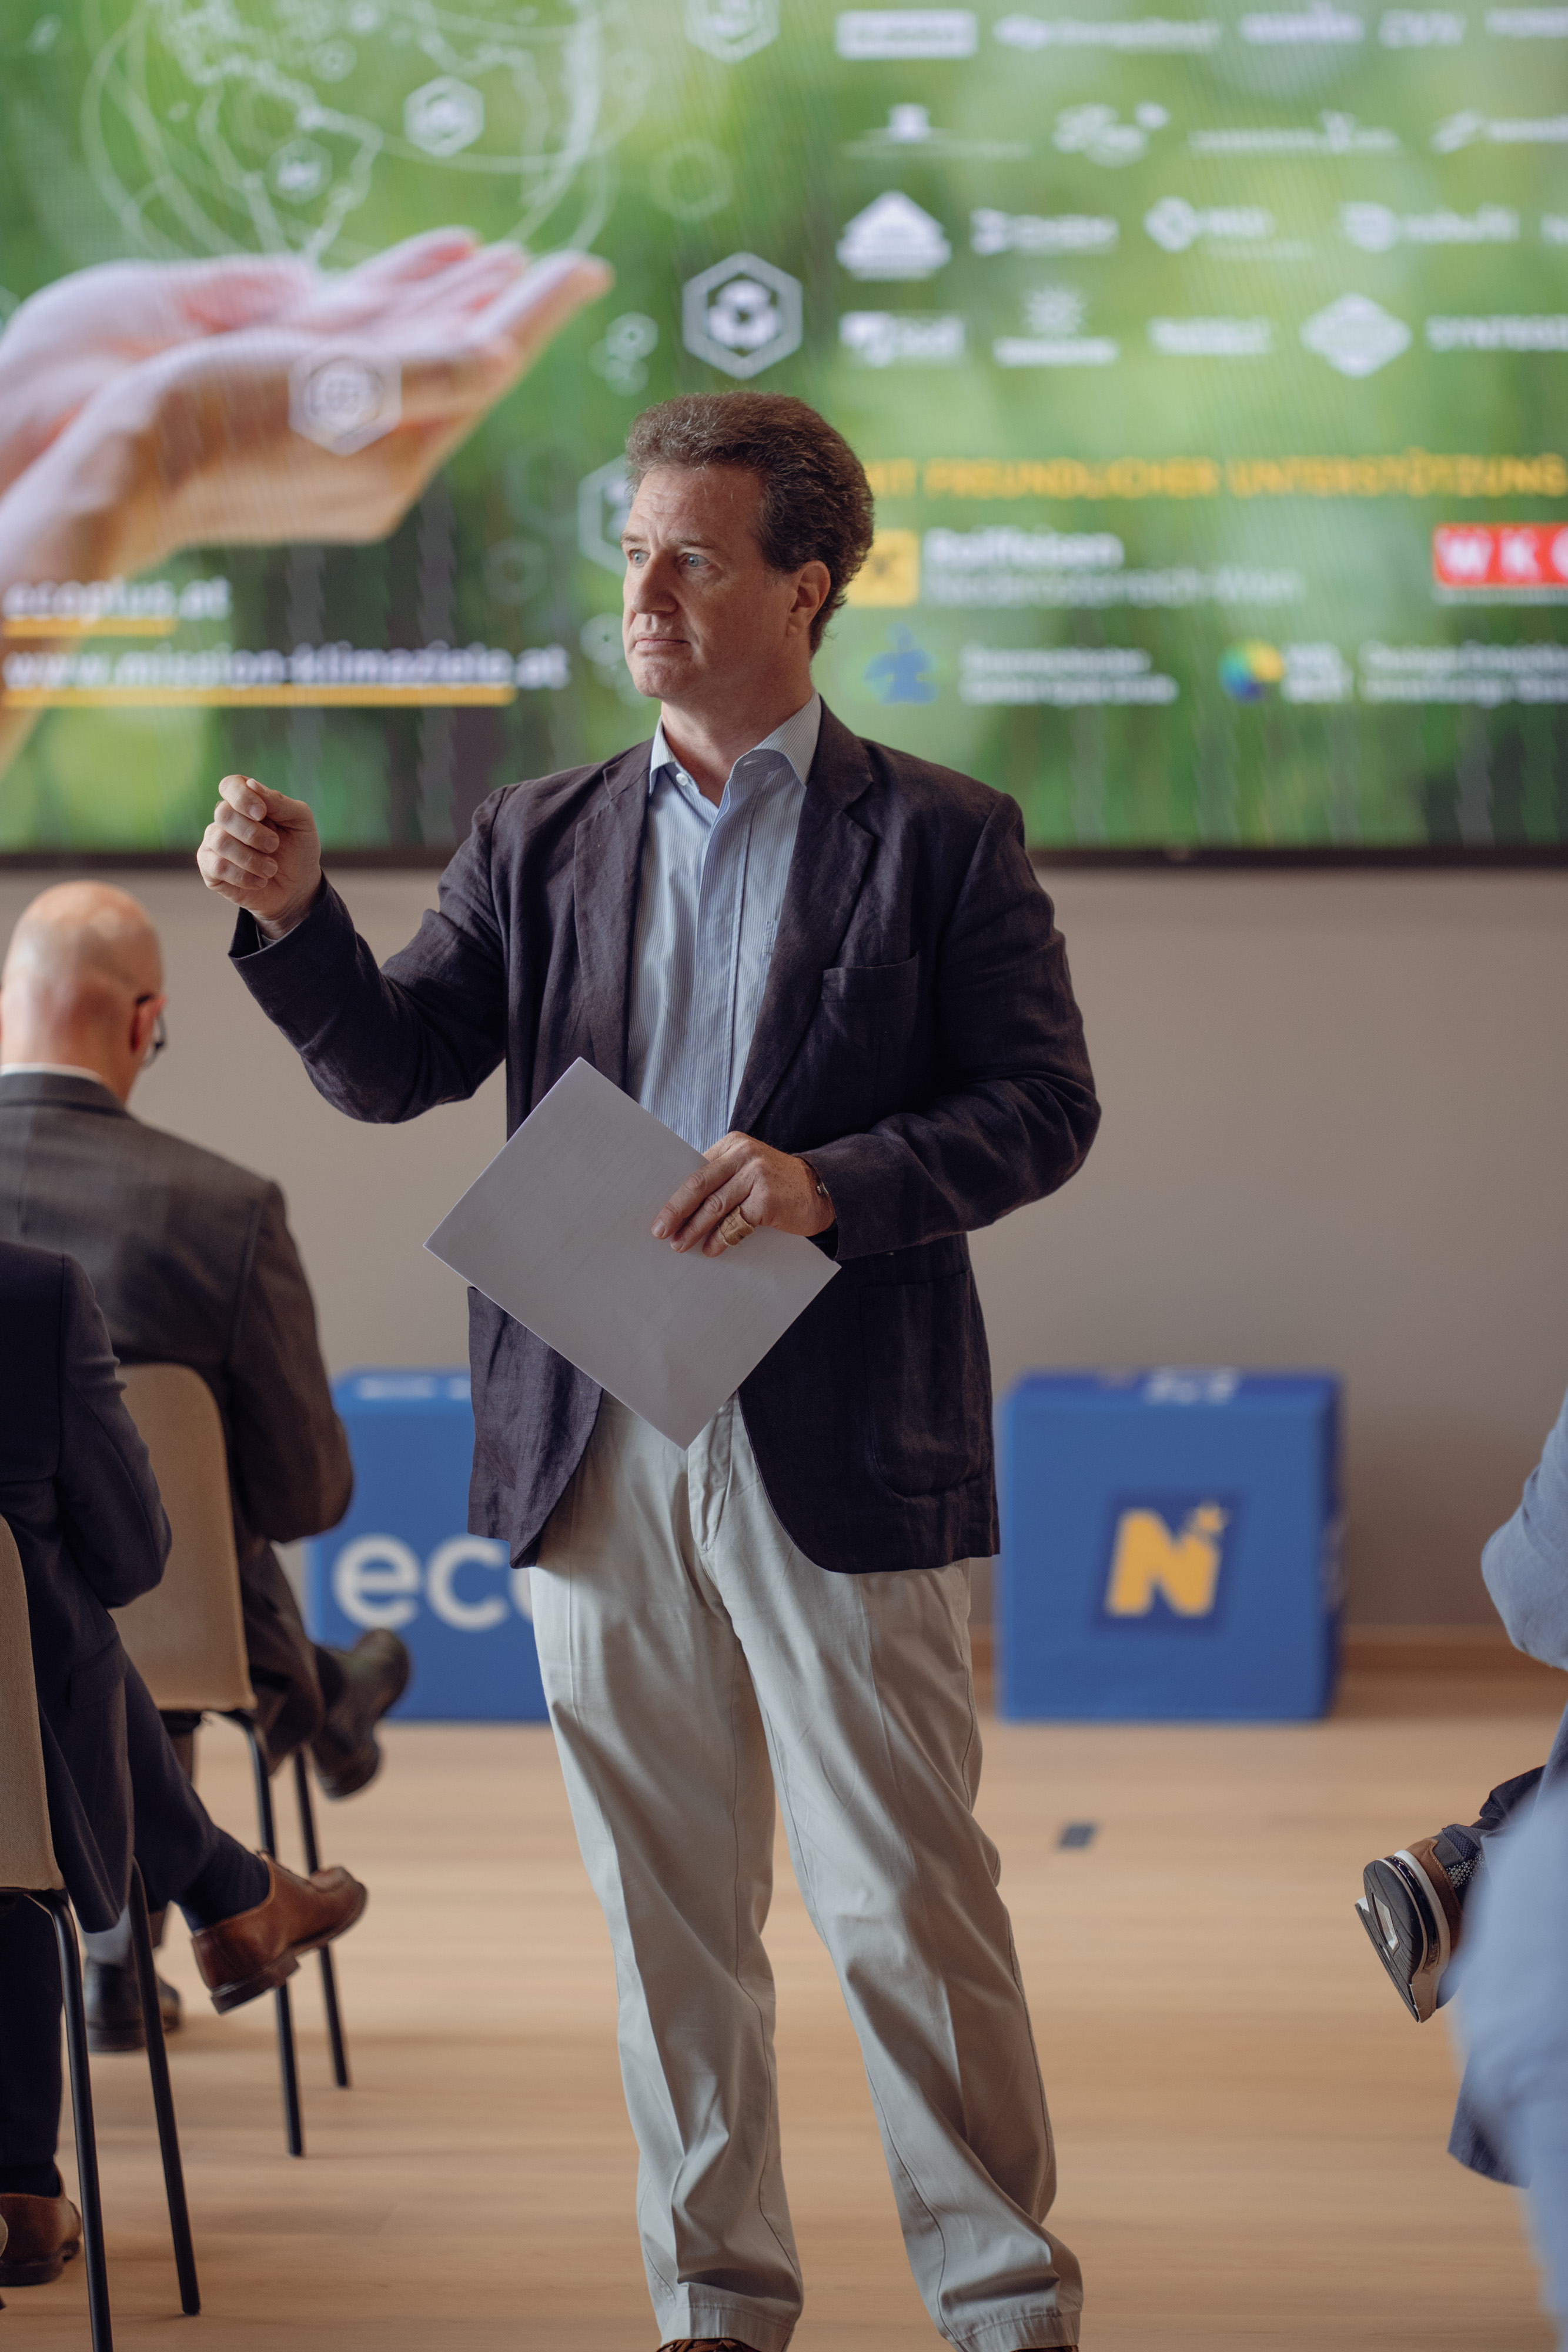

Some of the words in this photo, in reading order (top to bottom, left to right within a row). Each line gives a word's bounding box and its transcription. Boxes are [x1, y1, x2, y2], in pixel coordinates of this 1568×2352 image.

[864, 459, 916, 497] IT
[924, 457, 1219, 500] FREUNDLICHER
[1226, 448, 1566, 497] UNTERSTÜTZUNG
[3, 575, 233, 627] ecoplus.at
[2, 642, 570, 690] www.mission-klimaziele.at
[332, 1532, 534, 1632] ec
